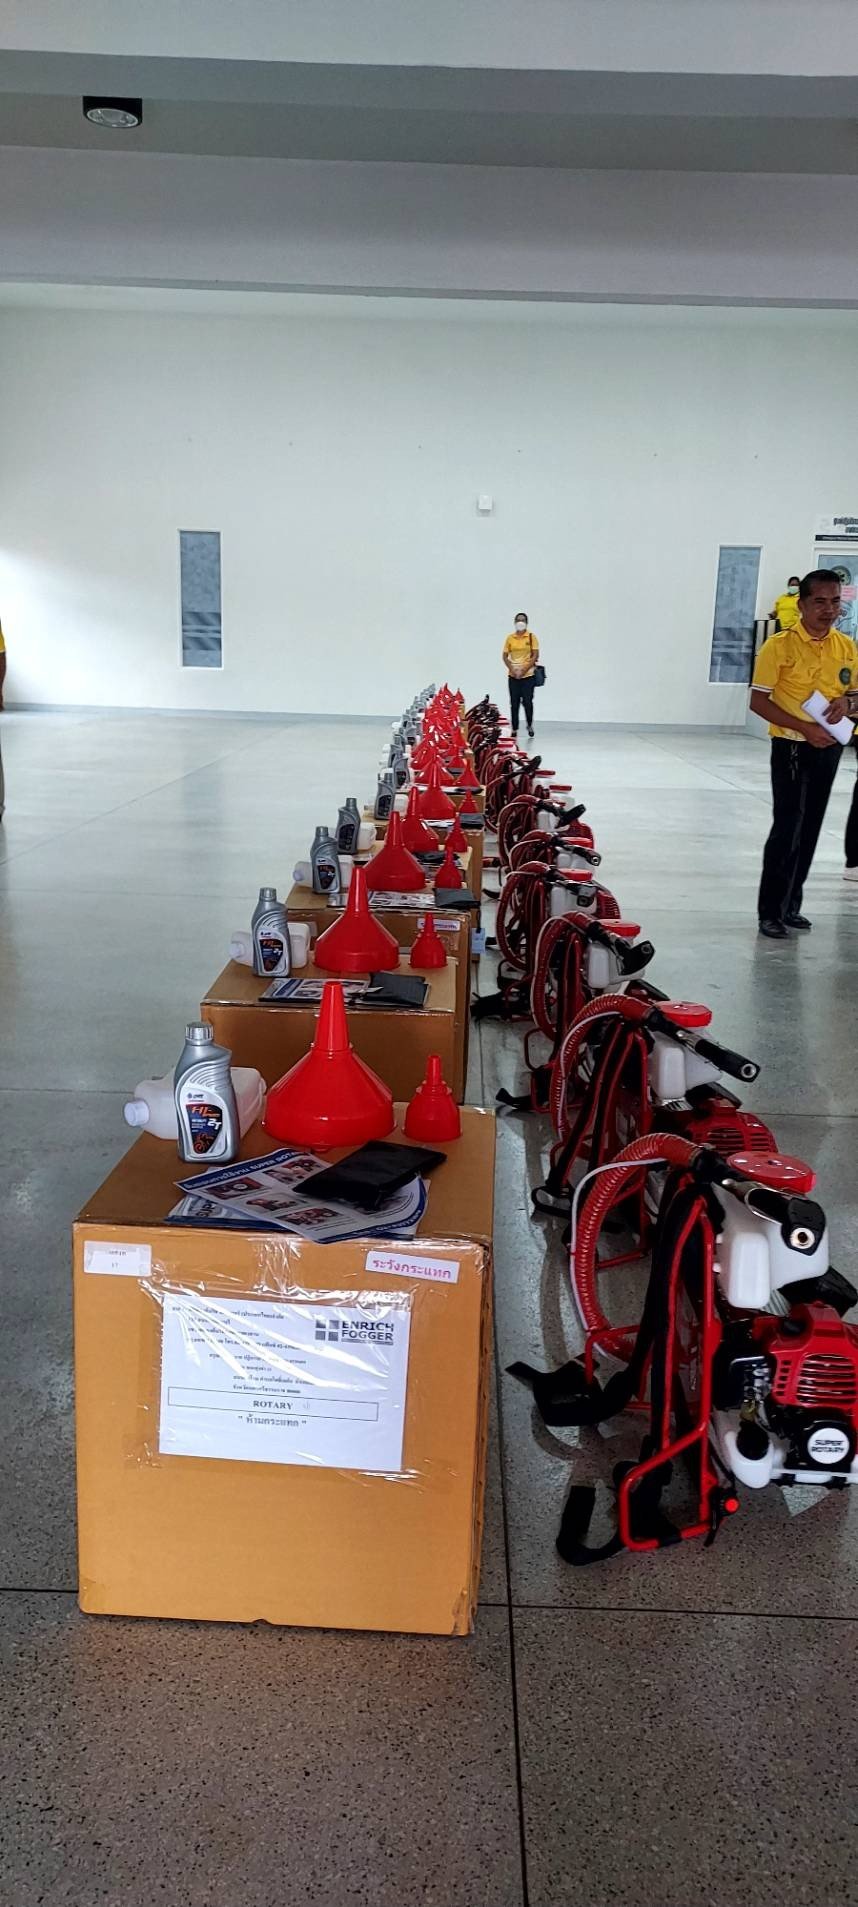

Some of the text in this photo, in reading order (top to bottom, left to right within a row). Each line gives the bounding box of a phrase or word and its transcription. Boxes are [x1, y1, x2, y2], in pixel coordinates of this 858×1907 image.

[372, 1258, 452, 1279] ระวังกระแทก
[341, 1321, 395, 1333] ENRICH
[341, 1330, 394, 1341] FOGGER
[252, 1400, 293, 1410] ROTARY
